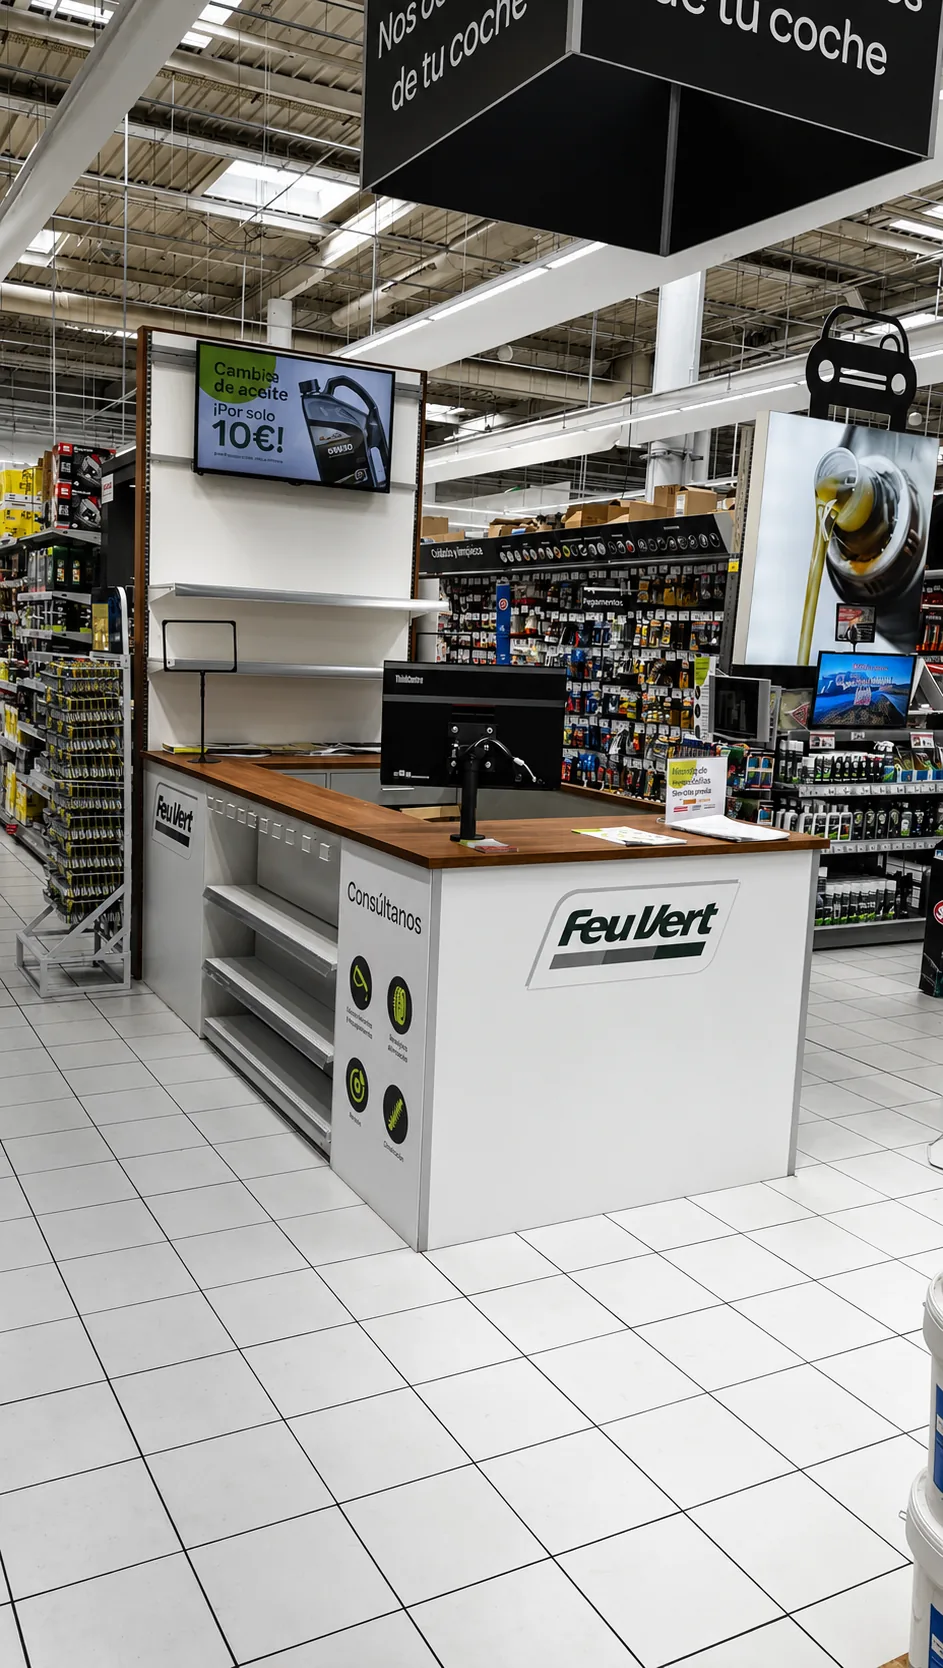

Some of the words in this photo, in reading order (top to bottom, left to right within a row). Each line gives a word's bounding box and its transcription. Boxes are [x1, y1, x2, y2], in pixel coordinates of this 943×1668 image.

[378, 1, 417, 59] Nos
[391, 65, 418, 111] de
[422, 45, 445, 88] tu
[450, 0, 528, 67] coche
[769, 8, 888, 76] coche
[214, 379, 234, 394] de
[238, 385, 288, 401] aceite
[246, 409, 276, 422] solo
[212, 419, 284, 454] 10€!
[347, 881, 422, 935] Consúltanos
